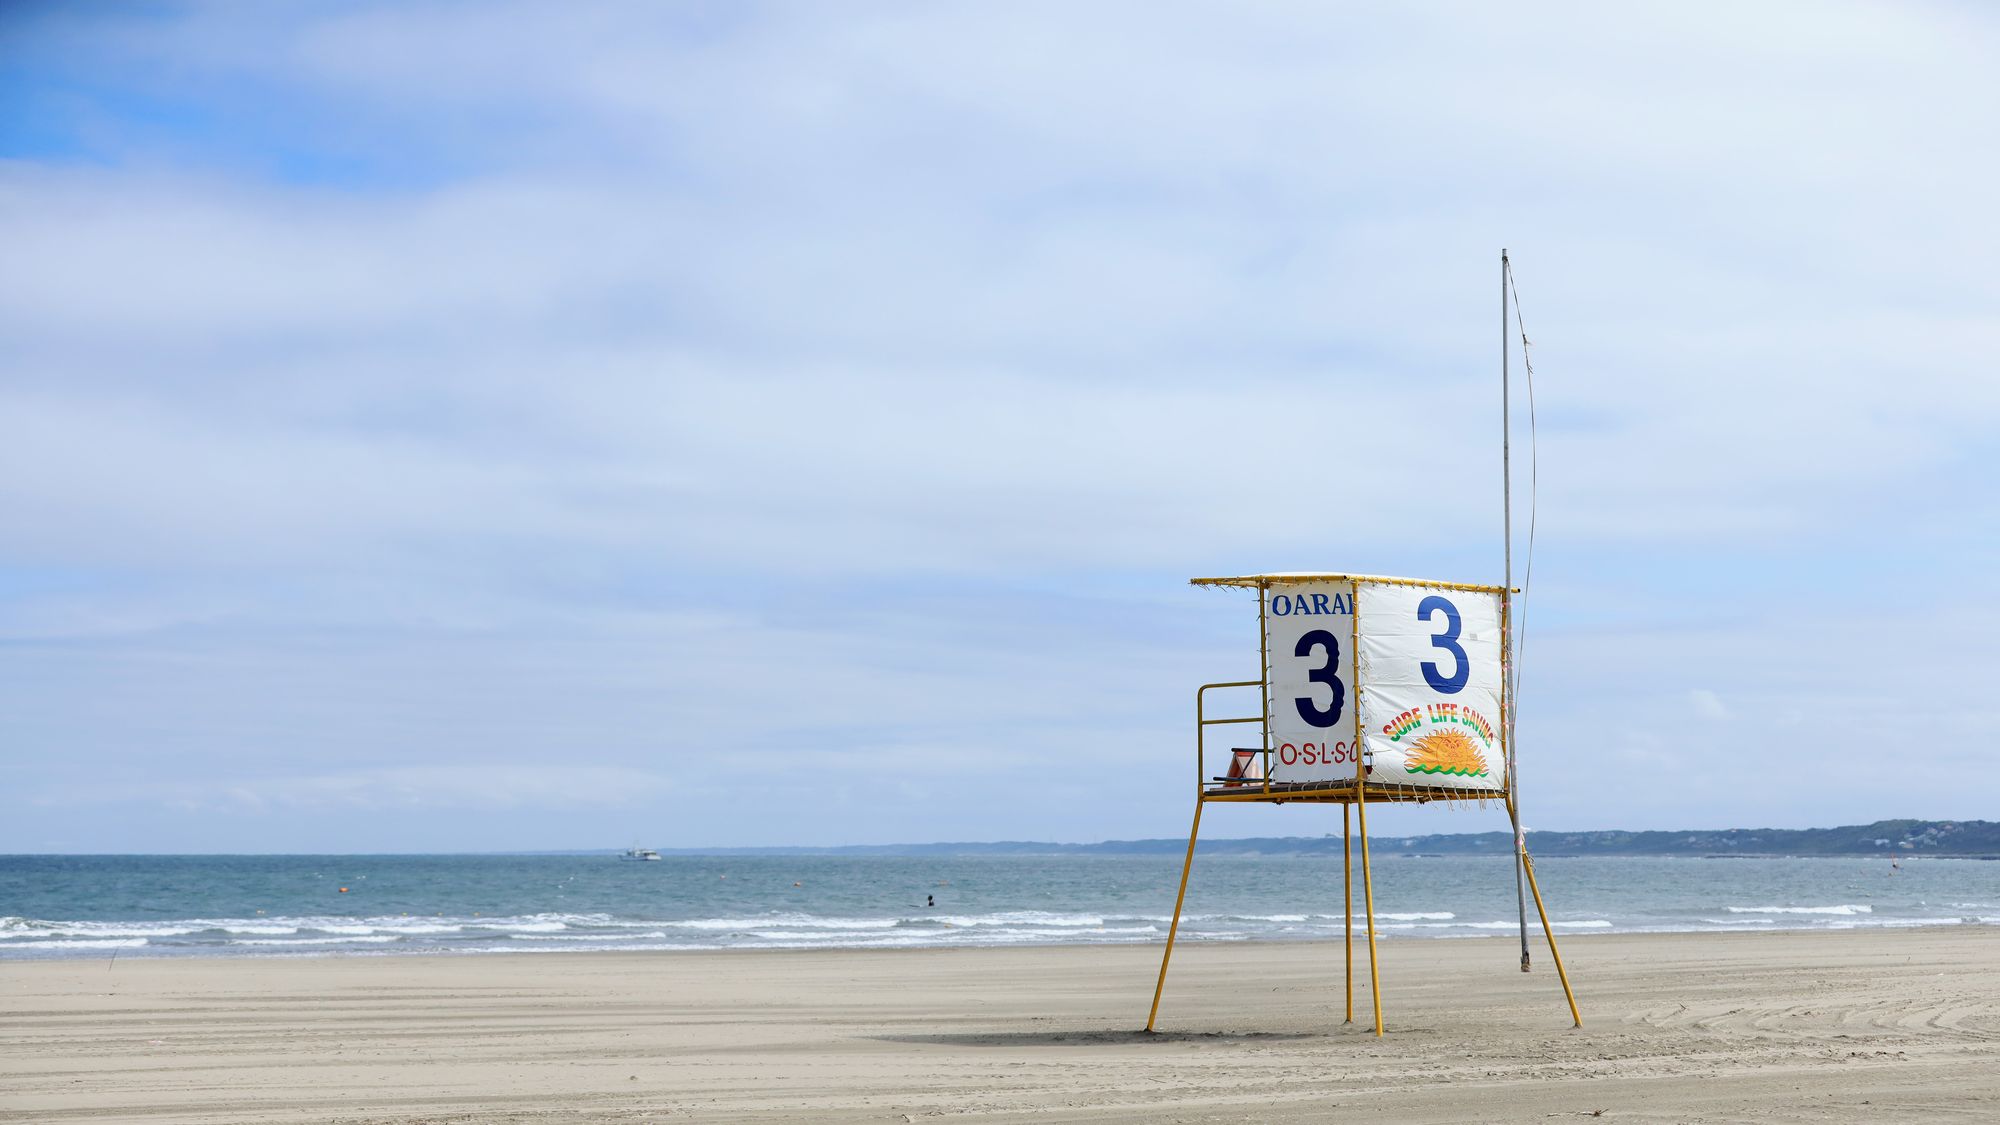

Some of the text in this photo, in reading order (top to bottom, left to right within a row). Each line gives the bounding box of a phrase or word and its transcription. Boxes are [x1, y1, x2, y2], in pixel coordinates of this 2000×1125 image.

[1294, 629, 1345, 728] 3
[1417, 595, 1470, 694] 3
[1382, 703, 1494, 749] SURF LIFE SAVING
